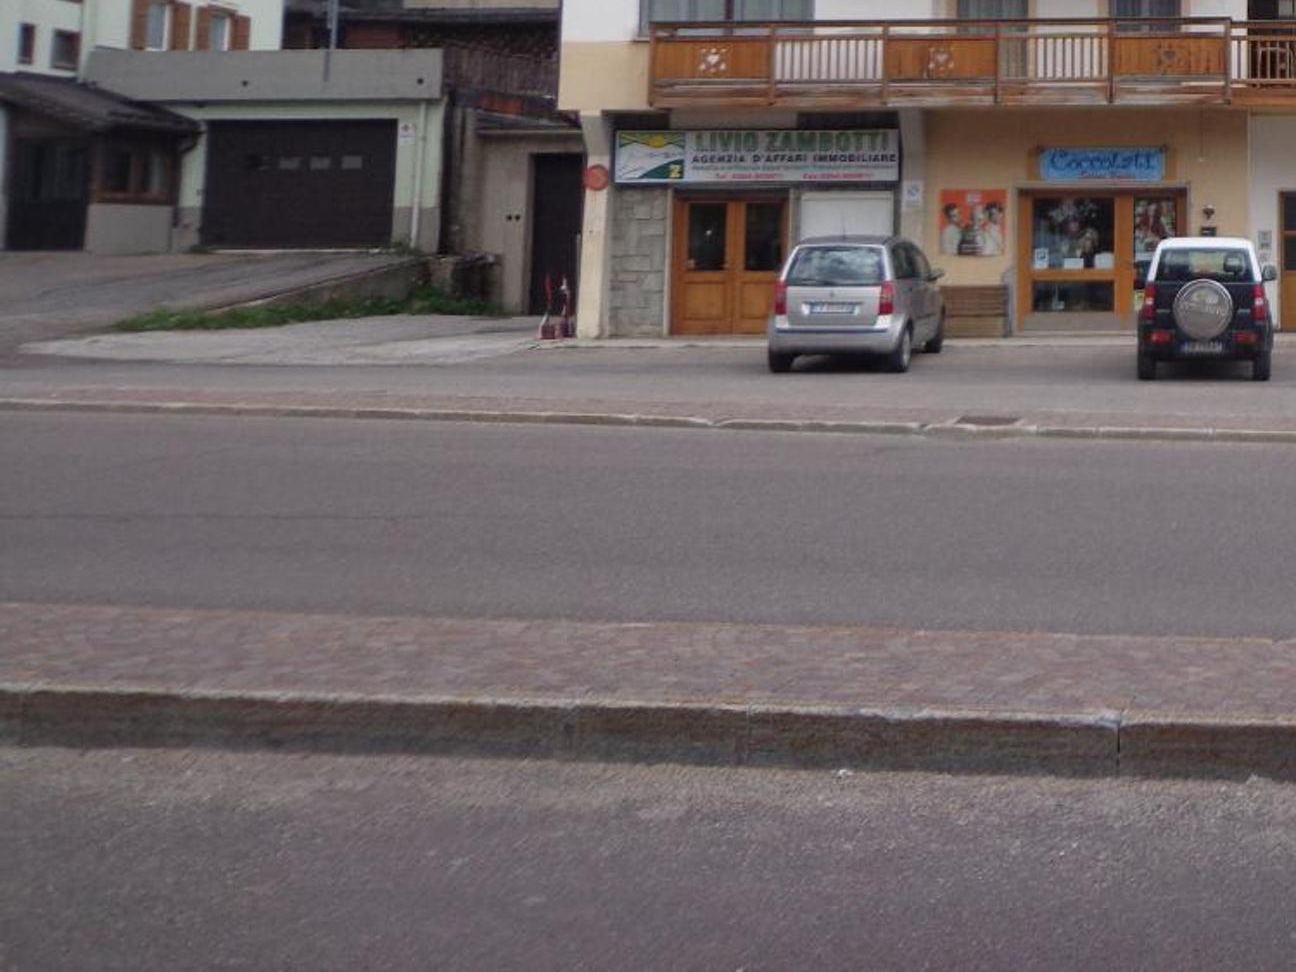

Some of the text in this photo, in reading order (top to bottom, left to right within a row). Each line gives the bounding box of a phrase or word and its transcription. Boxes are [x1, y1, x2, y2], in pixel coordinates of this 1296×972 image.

[694, 131, 759, 152] LIVIO
[691, 153, 897, 164] AGENZIA D'AFFARI IMMOBILIARE
